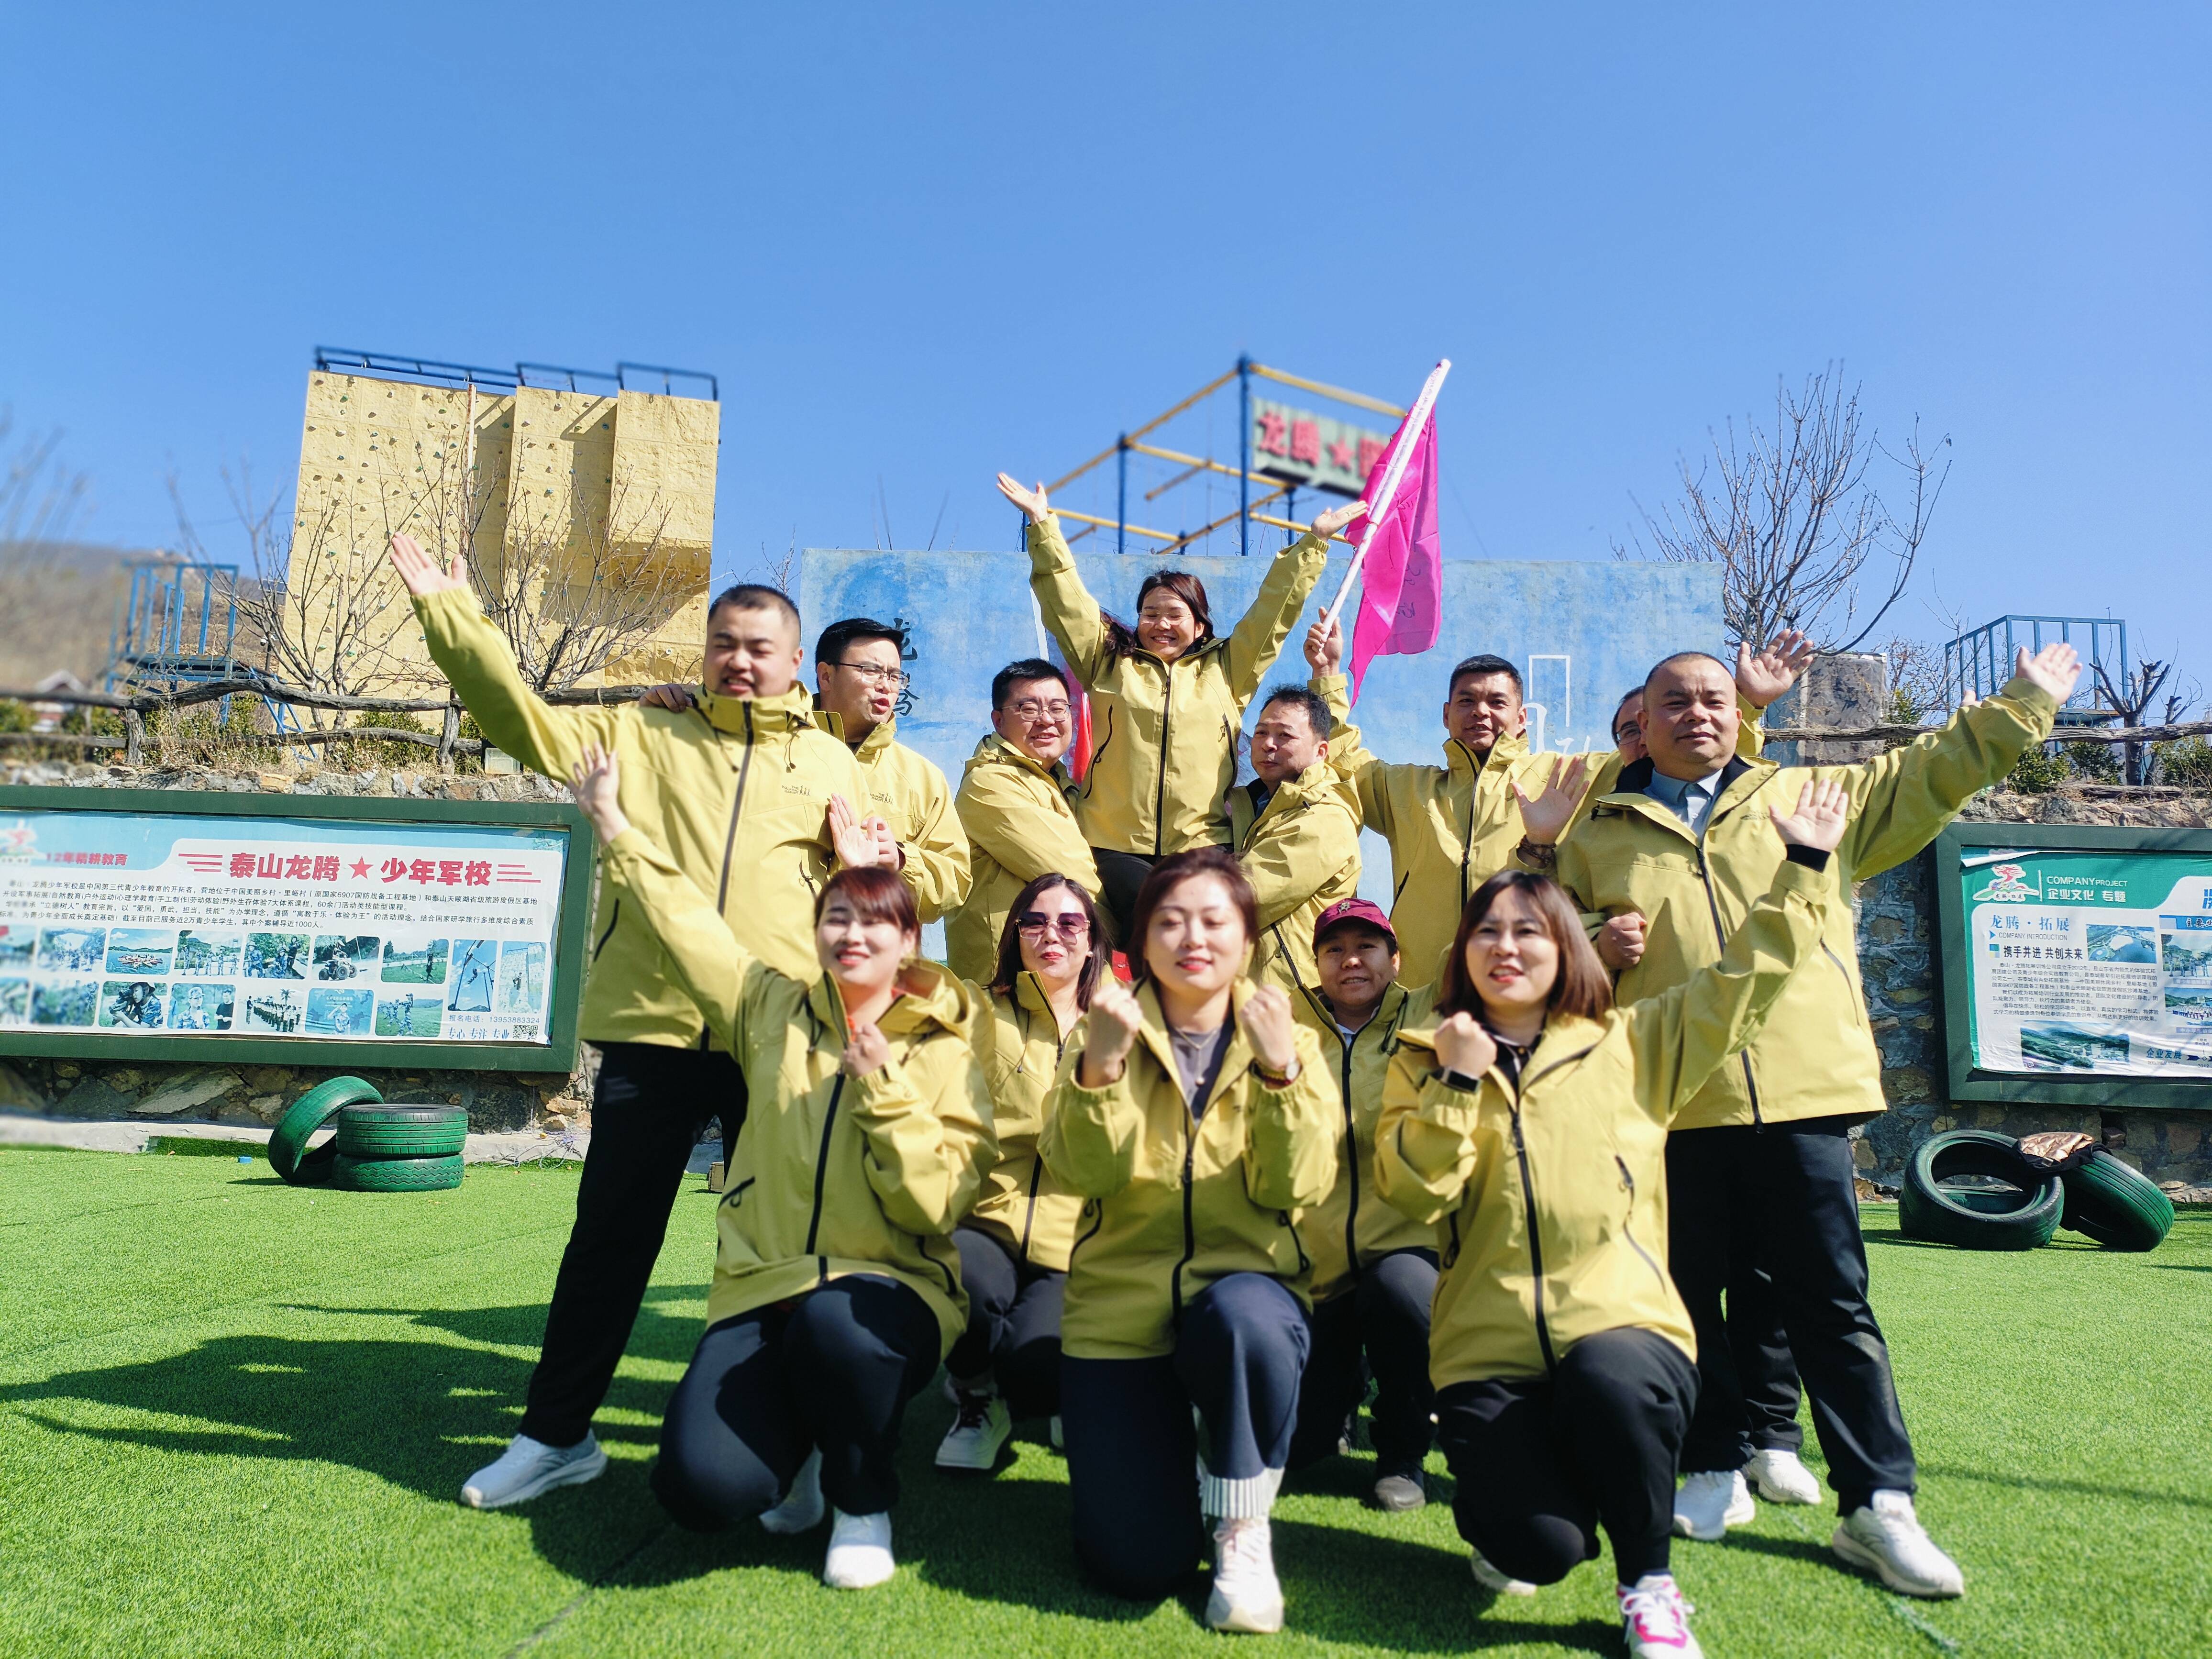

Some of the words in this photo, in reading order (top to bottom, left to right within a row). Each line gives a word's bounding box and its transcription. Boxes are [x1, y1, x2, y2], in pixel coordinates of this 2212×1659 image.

[229, 852, 340, 882] 泰山龙腾
[380, 857, 492, 886] 少年军校
[2047, 888, 2095, 901] 企业文化
[2102, 890, 2126, 903] 专题
[2003, 945, 2042, 959] 携手并进
[2045, 946, 2083, 960] 共创未来
[2146, 1048, 2182, 1059] 企业发展
